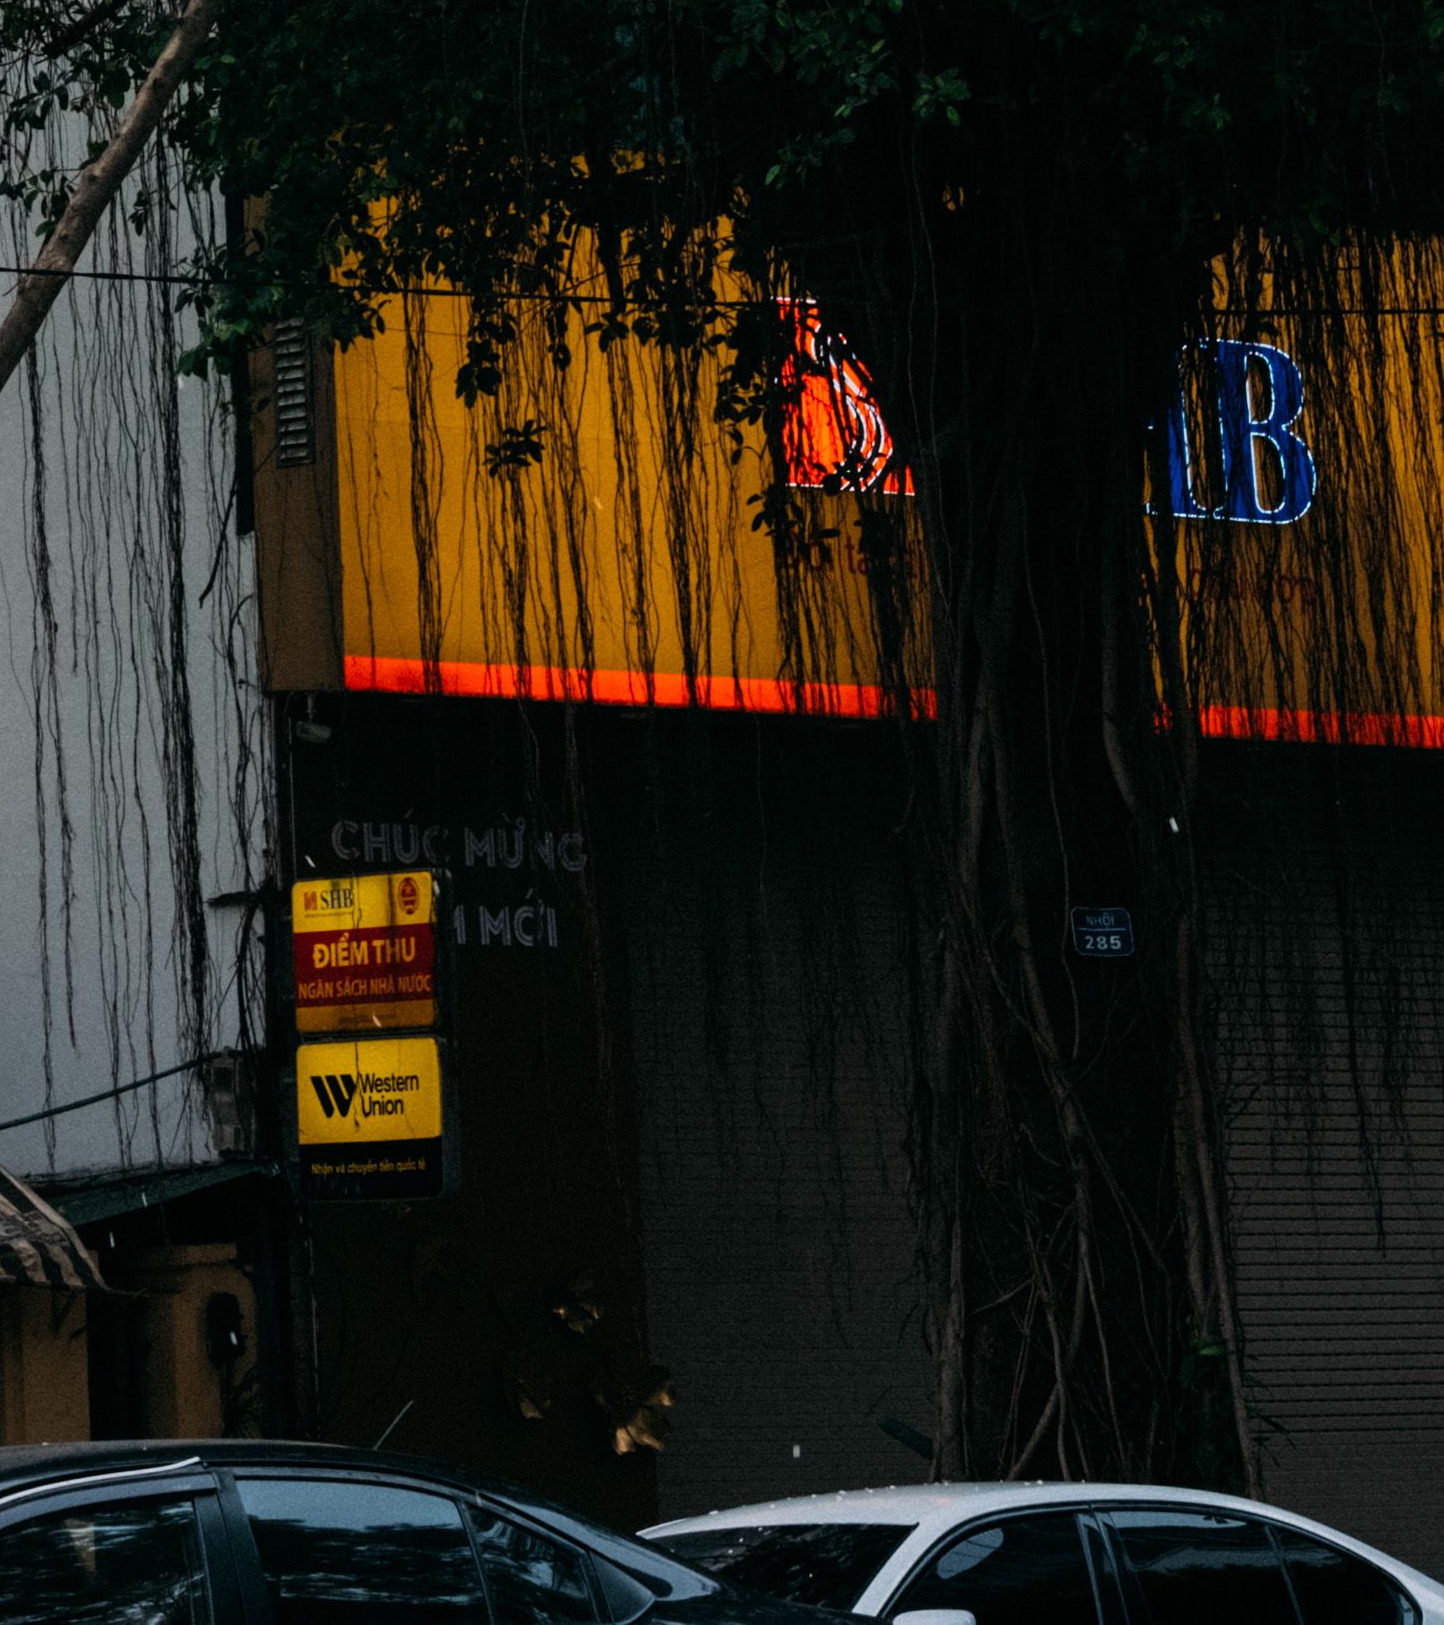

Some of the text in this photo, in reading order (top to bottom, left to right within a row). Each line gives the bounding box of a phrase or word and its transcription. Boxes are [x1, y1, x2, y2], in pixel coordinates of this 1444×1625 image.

[320, 889, 354, 910] SHB
[312, 932, 416, 969] ĐIỂM THU
[1084, 935, 1123, 950] 285
[298, 971, 431, 999] NGÂN SÁCH NHÀ NƯỚC
[359, 1074, 419, 1093] Western
[362, 1095, 404, 1117] Union
